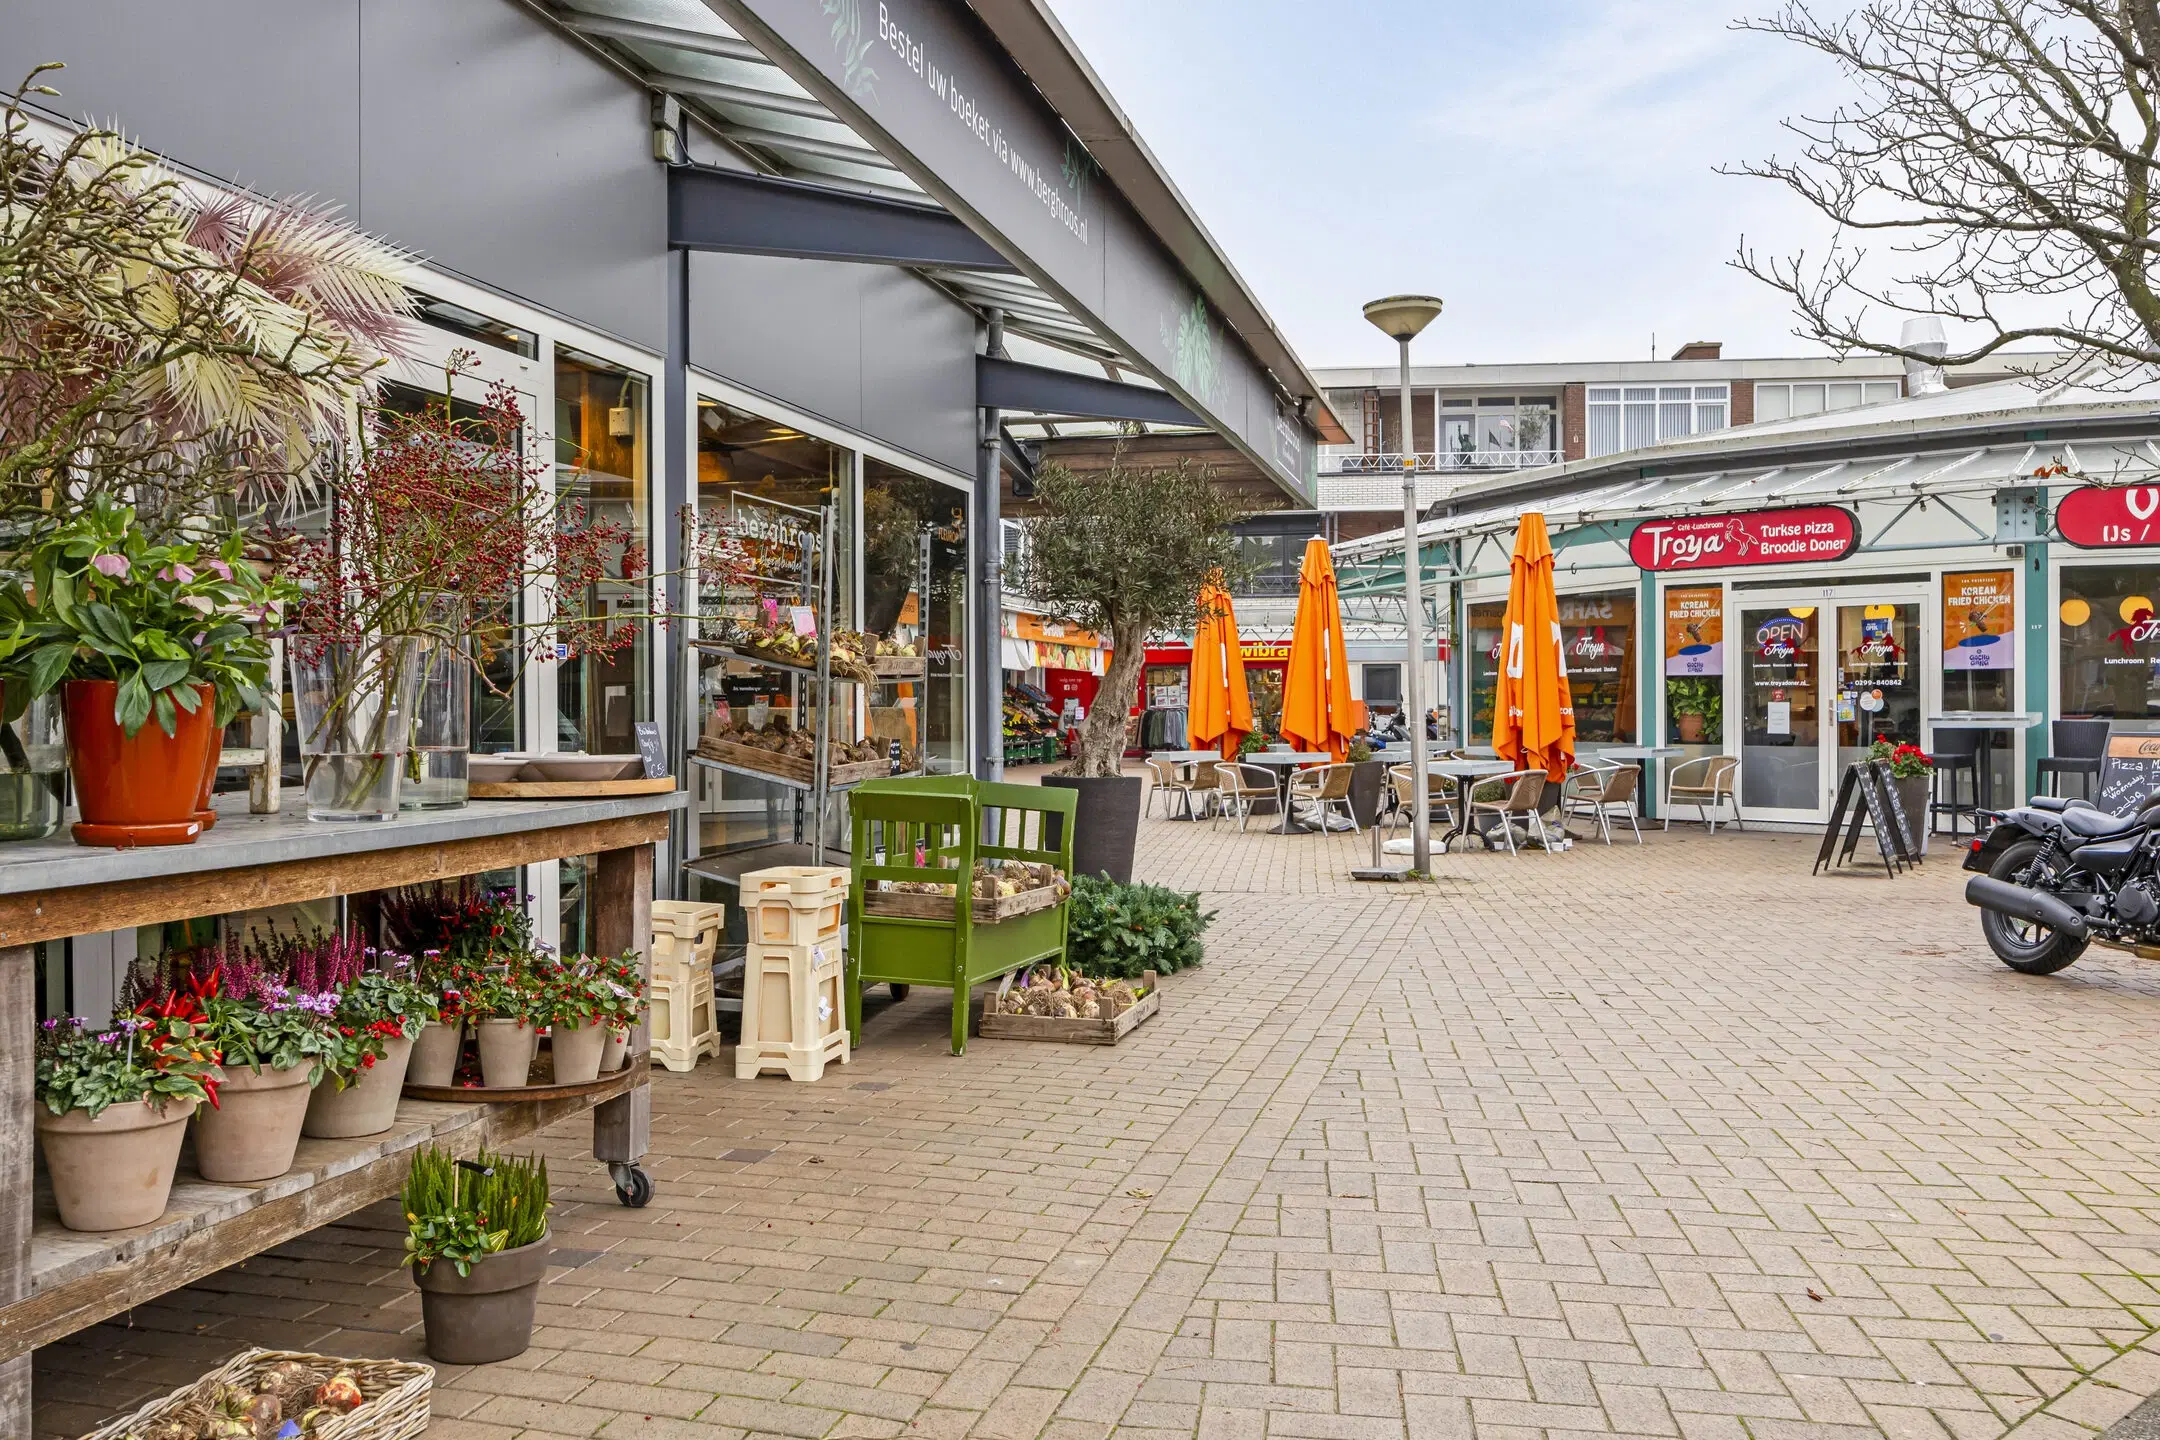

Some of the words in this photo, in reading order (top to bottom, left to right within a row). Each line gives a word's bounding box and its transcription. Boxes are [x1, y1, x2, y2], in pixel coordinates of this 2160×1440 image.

[879, 1, 924, 79] Bestel
[928, 61, 947, 101] uw
[950, 75, 990, 147] boeket
[992, 129, 1008, 165] via
[1010, 148, 1088, 245] www.berghroos.nl
[1760, 524, 1801, 538] Turkse
[1804, 522, 1834, 535] pizza
[2103, 525, 2131, 542] IJs
[1641, 525, 1724, 566] Troya
[1760, 542, 1806, 555] Broodje
[1809, 538, 1846, 551] Doner
[1822, 588, 1834, 597] 117
[1960, 585, 1997, 597] KOREAN
[1680, 600, 1709, 610] KOREAN
[1948, 596, 1972, 607] FRIED
[1973, 594, 2011, 605] CHICKEN
[1669, 609, 1689, 619] FRIED
[1690, 608, 1720, 618] CHICKEN
[1756, 622, 1804, 645] OPEN
[1240, 642, 1289, 657] wibra
[1576, 637, 1605, 659] Troya
[1764, 643, 1795, 658] Troya
[1861, 641, 1894, 657] Troya
